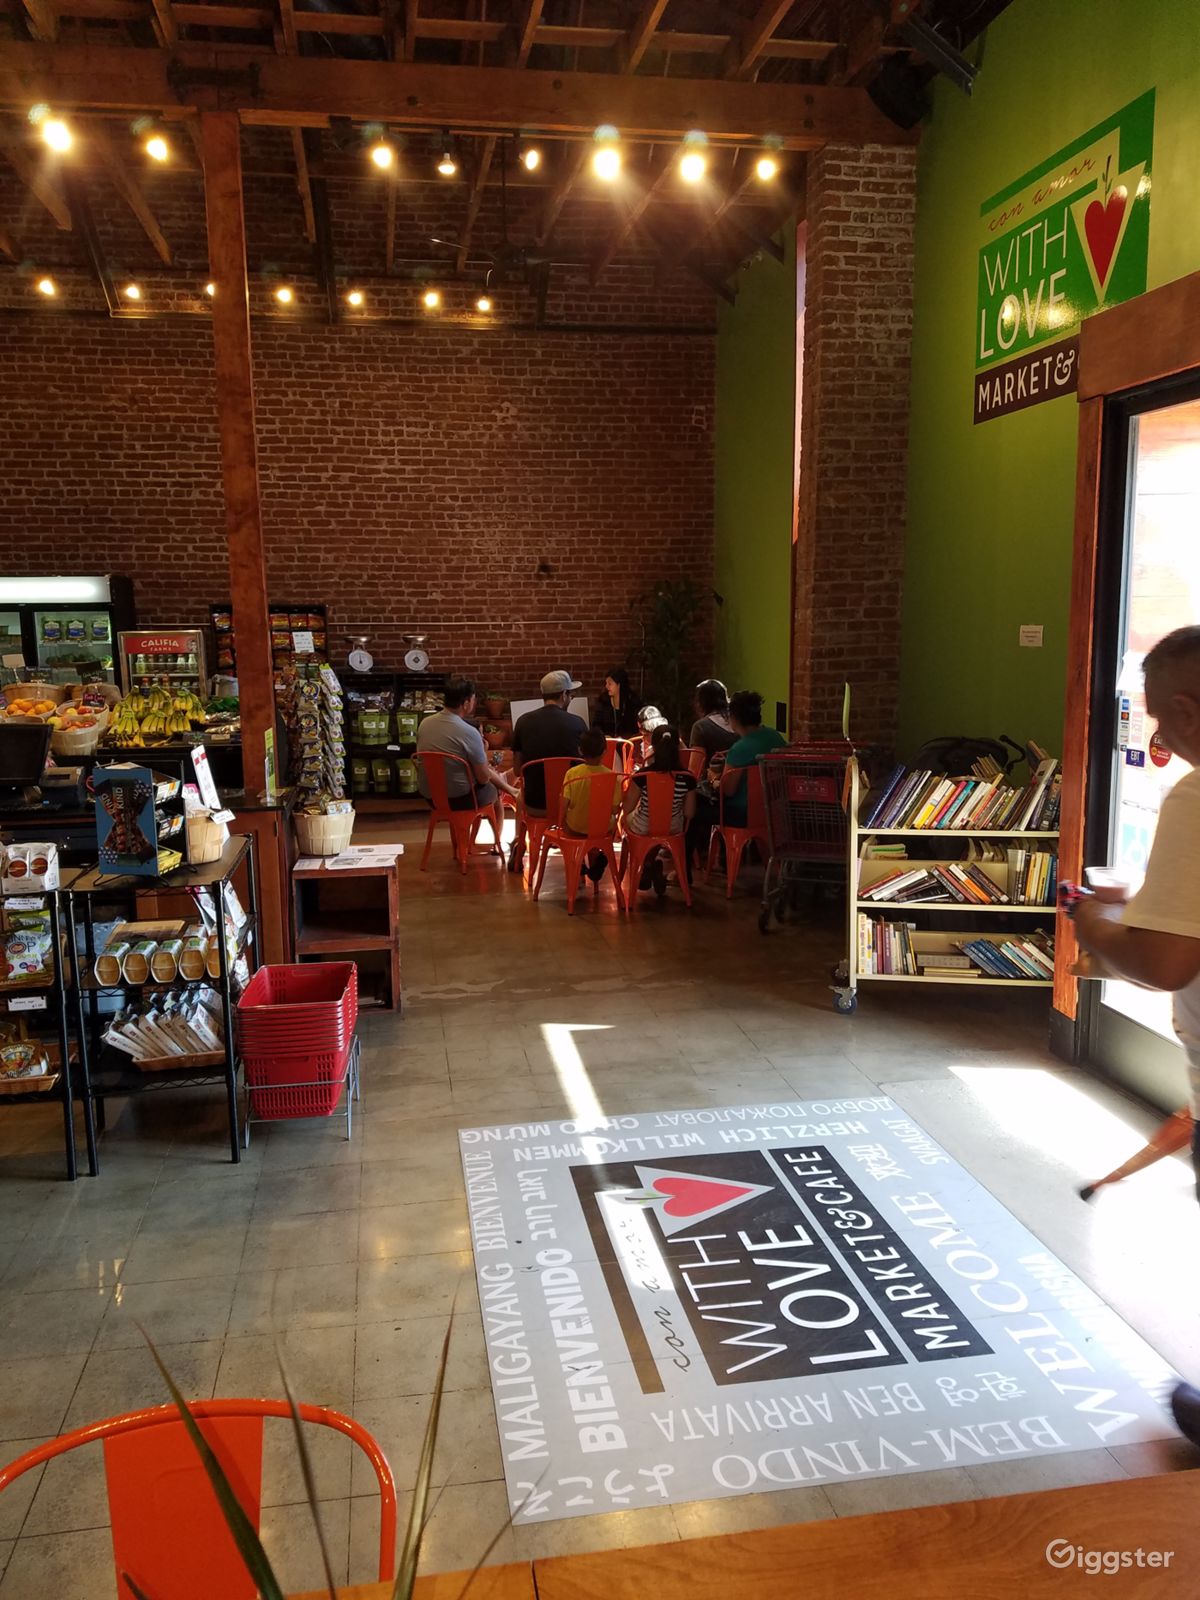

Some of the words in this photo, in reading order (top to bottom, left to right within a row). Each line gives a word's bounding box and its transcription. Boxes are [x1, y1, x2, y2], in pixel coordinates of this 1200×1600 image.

[988, 202, 1024, 233] con
[1032, 156, 1096, 206] amor
[983, 206, 1068, 296] WITH
[980, 268, 1067, 360] LOVE
[141, 639, 179, 648] CALIFIA
[1130, 750, 1141, 761] EBT
[116, 787, 124, 810] KIND
[718, 1120, 870, 1144] HERZLICH
[811, 1096, 894, 1116] ДОБРО
[514, 1132, 706, 1162] WILLKOMMEN
[465, 1150, 509, 1253] BIENVENUE
[667, 1233, 788, 1375] WITH
[737, 1224, 890, 1365] LOVE
[889, 1191, 1140, 1442] WELCOME
[477, 1261, 549, 1462] MALIGAYANG
[535, 1247, 629, 1454] BIENVENIDO
[654, 1306, 691, 1373] con
[651, 1390, 834, 1443] ARRIVATA
[842, 1382, 926, 1420] BEN
[935, 1371, 1027, 1407] 환영
[712, 1415, 1071, 1490] BEM-VINDO
[513, 1464, 674, 1516] ようこそ
